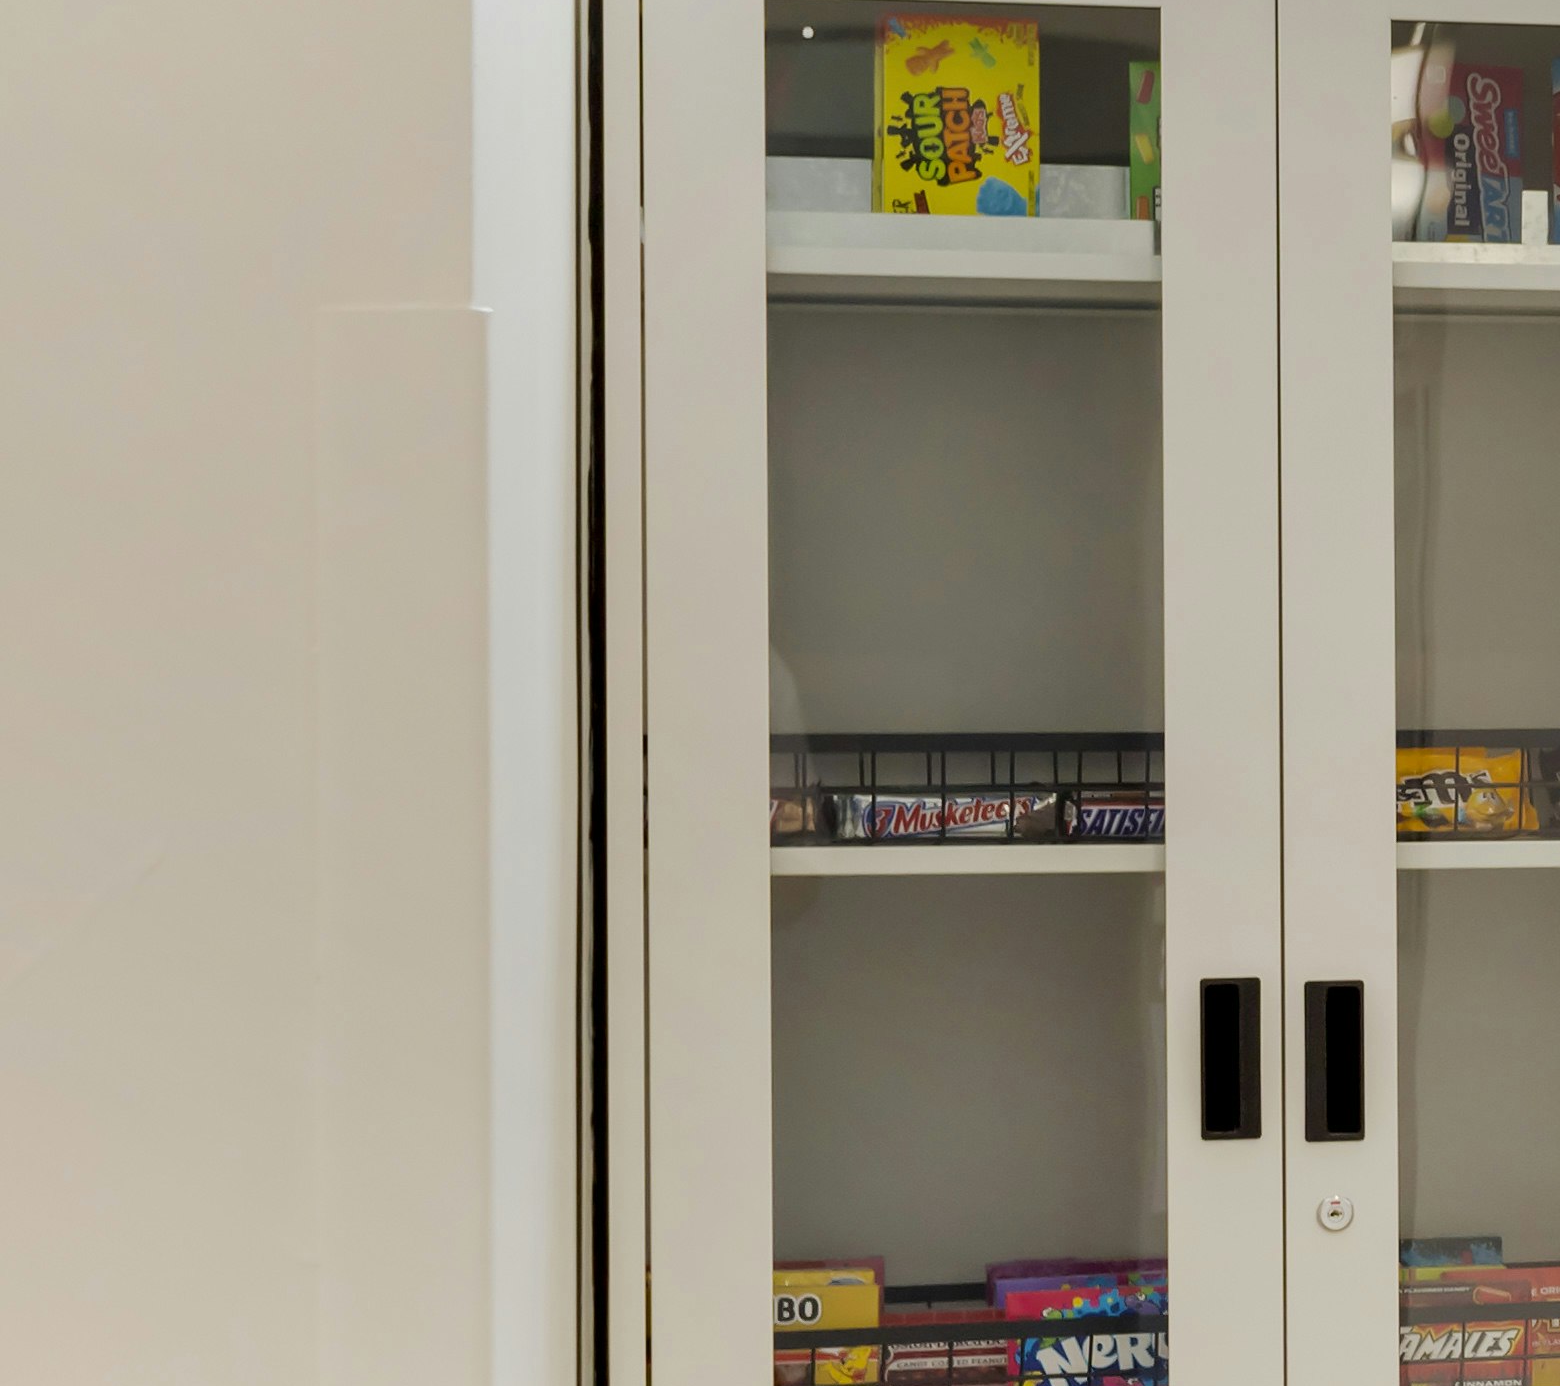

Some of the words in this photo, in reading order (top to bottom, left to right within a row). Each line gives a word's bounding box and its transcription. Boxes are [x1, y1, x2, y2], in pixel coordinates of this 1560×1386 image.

[912, 93, 946, 181] SOUR
[941, 87, 978, 185] PATCH
[1453, 133, 1472, 226] Original
